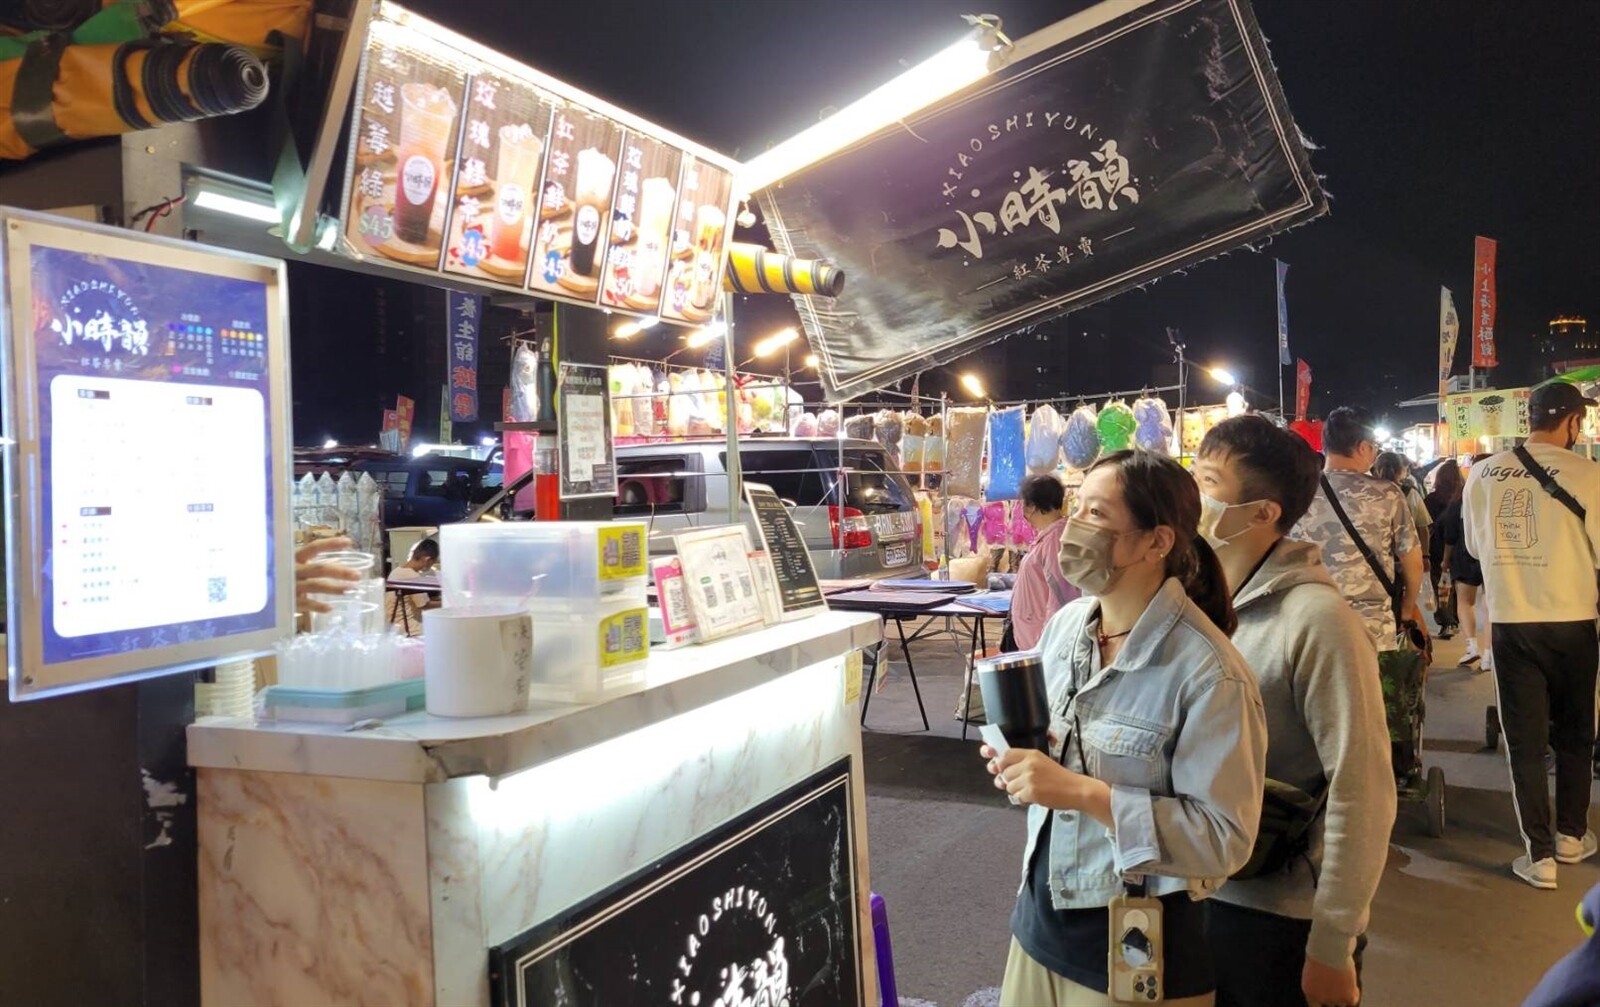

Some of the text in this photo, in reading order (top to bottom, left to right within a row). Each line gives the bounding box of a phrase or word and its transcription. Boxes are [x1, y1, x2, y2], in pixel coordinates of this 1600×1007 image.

[936, 139, 1139, 260] 小時韻
[1012, 236, 1094, 281] 紅茶專賣
